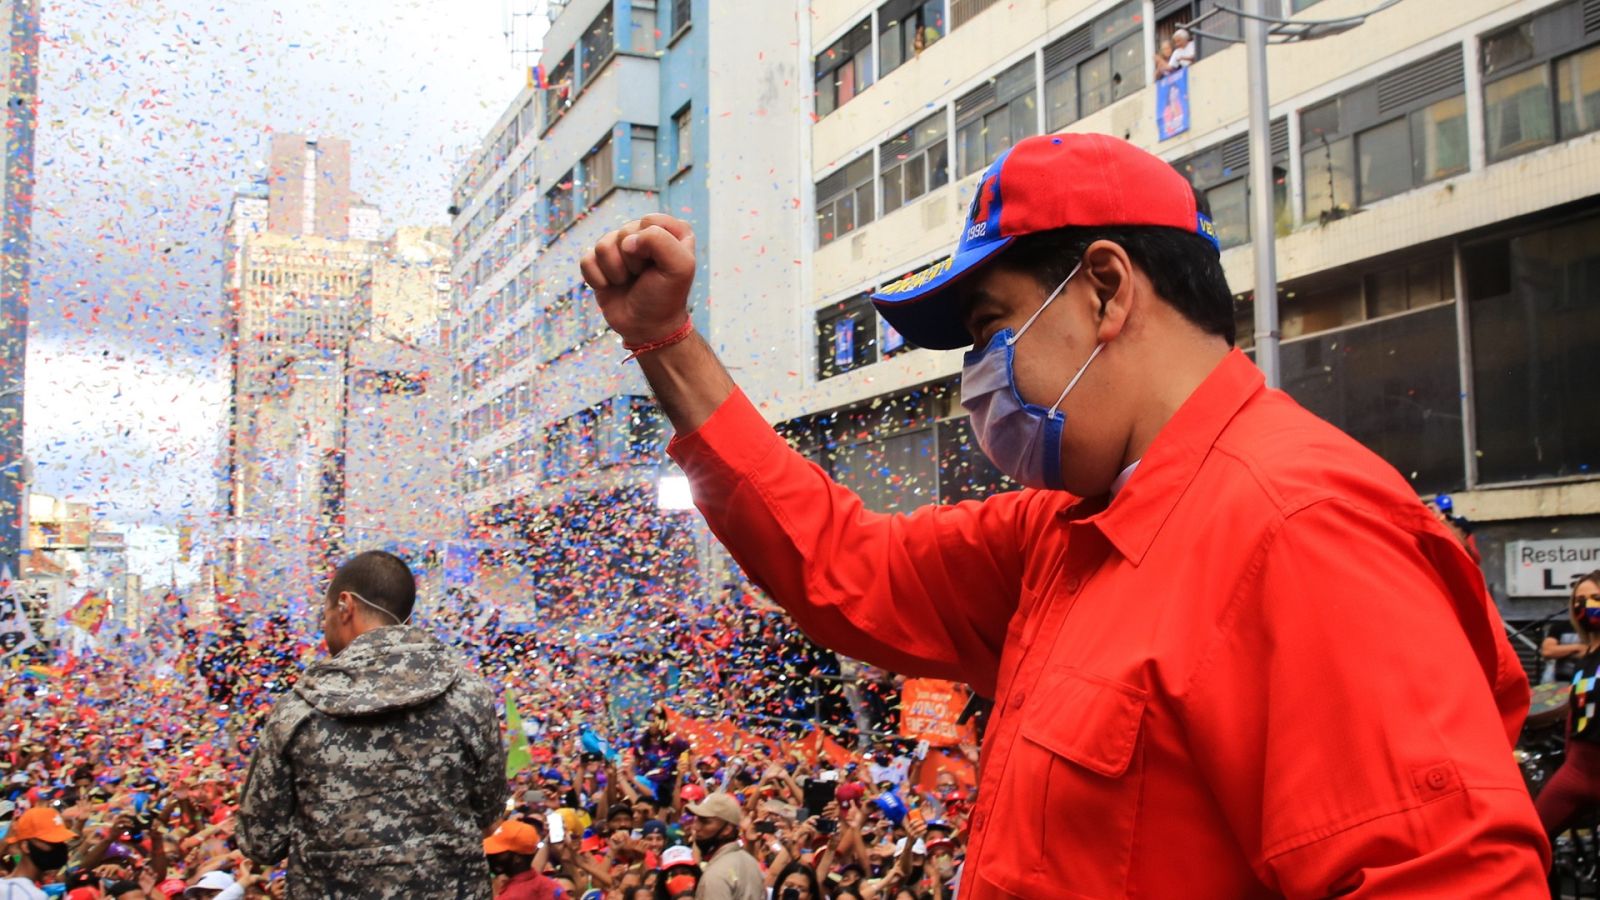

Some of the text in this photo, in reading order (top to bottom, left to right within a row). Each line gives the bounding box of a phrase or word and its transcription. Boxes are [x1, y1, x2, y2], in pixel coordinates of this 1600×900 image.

[966, 221, 987, 242] 1992
[1199, 217, 1215, 238] VE
[1521, 545, 1600, 563] Restaur
